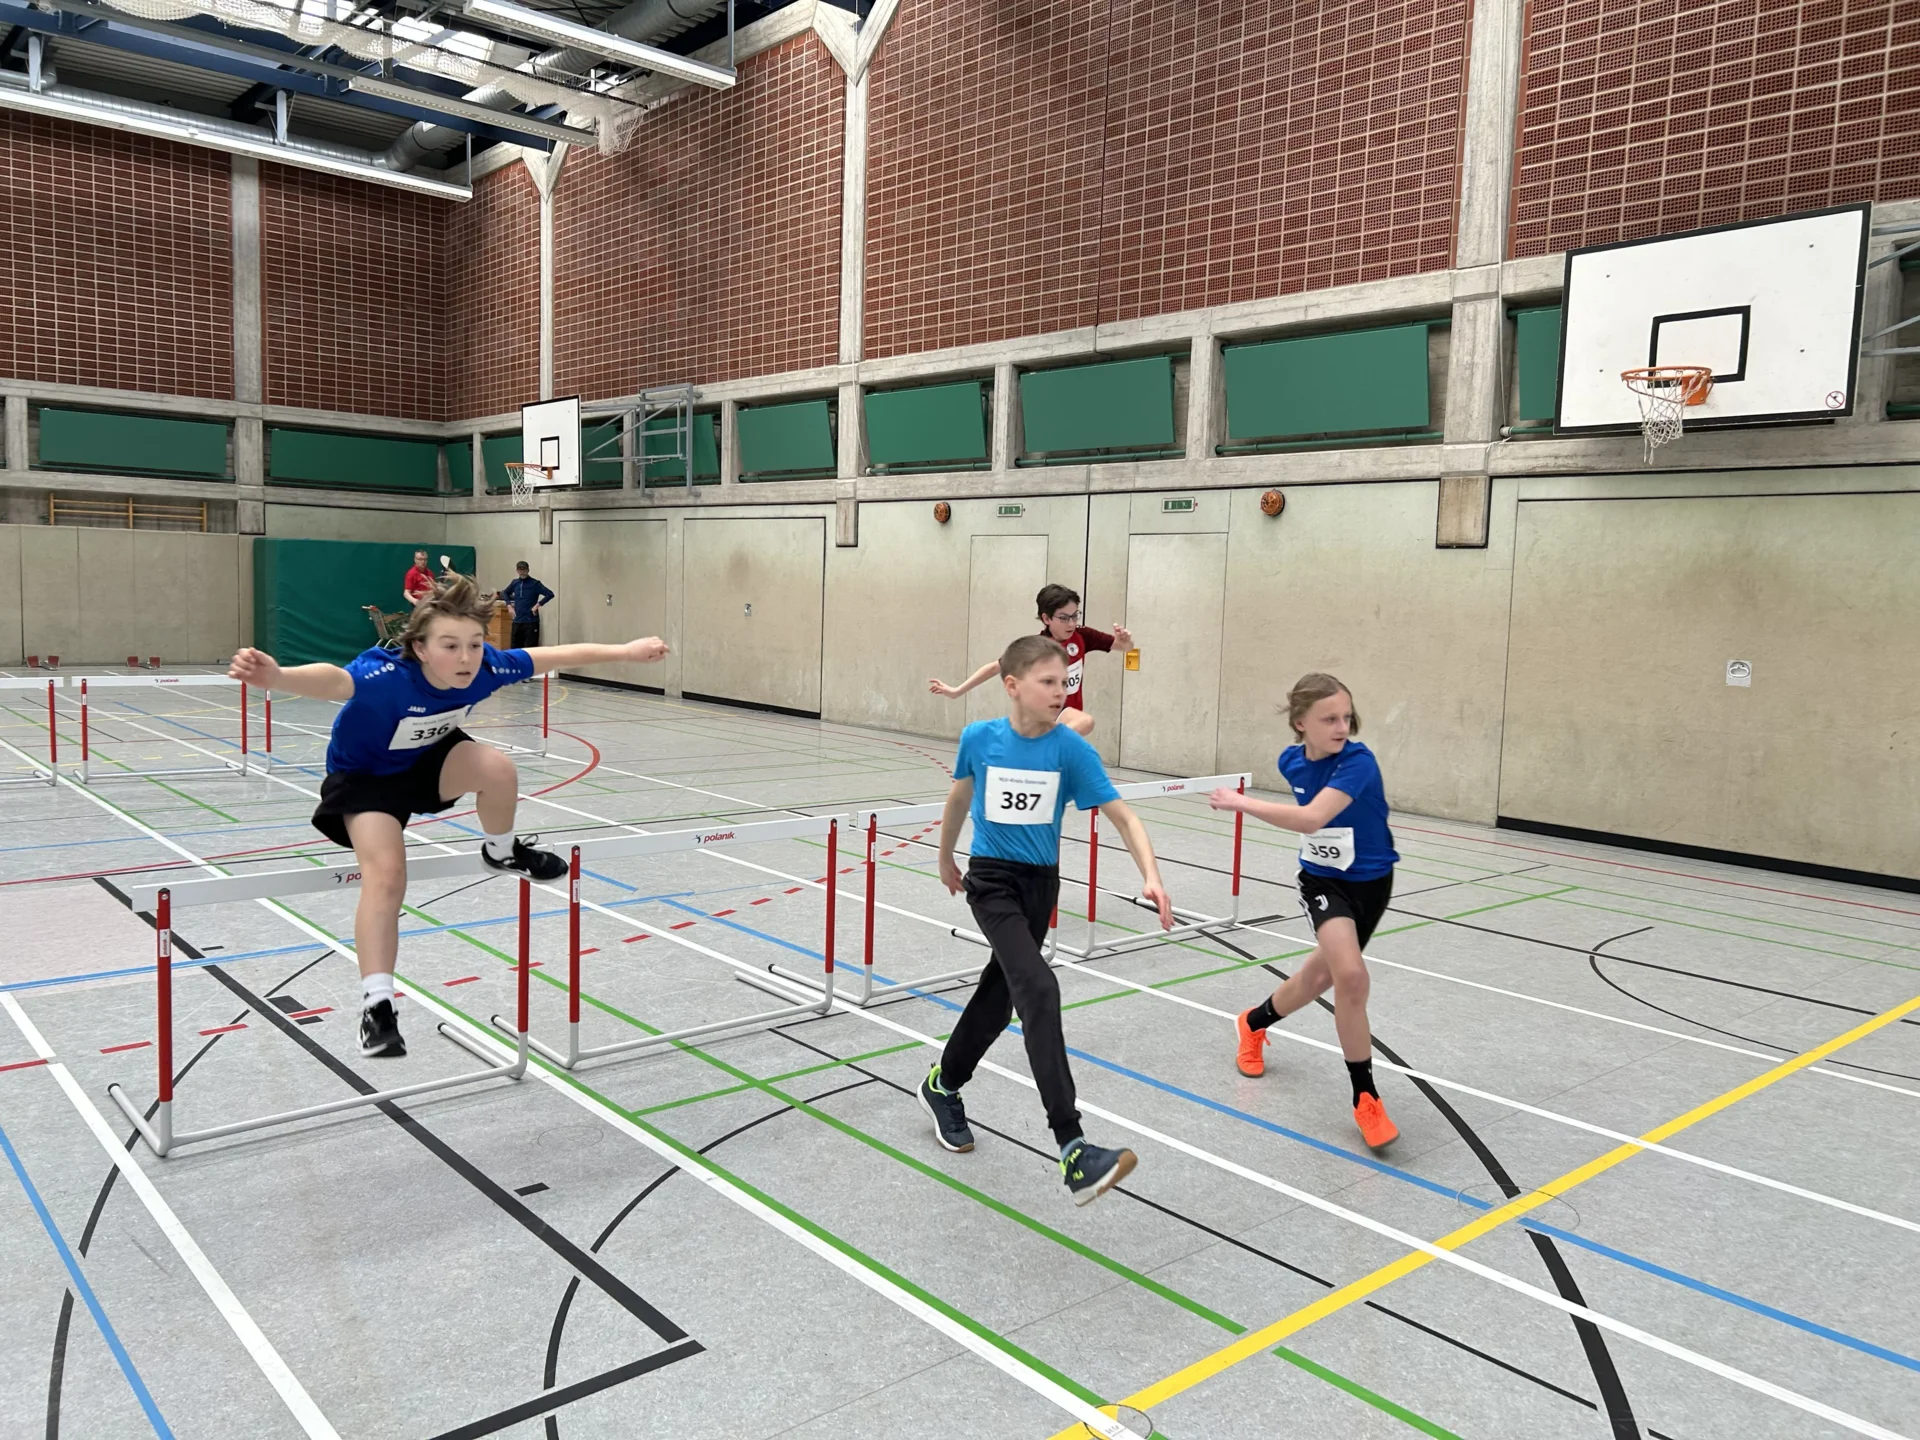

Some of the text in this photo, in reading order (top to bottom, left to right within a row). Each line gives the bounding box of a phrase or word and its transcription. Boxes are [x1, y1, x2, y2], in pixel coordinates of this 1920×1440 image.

[410, 723, 450, 740] 336
[1000, 791, 1041, 811] 387
[703, 831, 735, 844] polanik
[1308, 843, 1341, 859] 359
